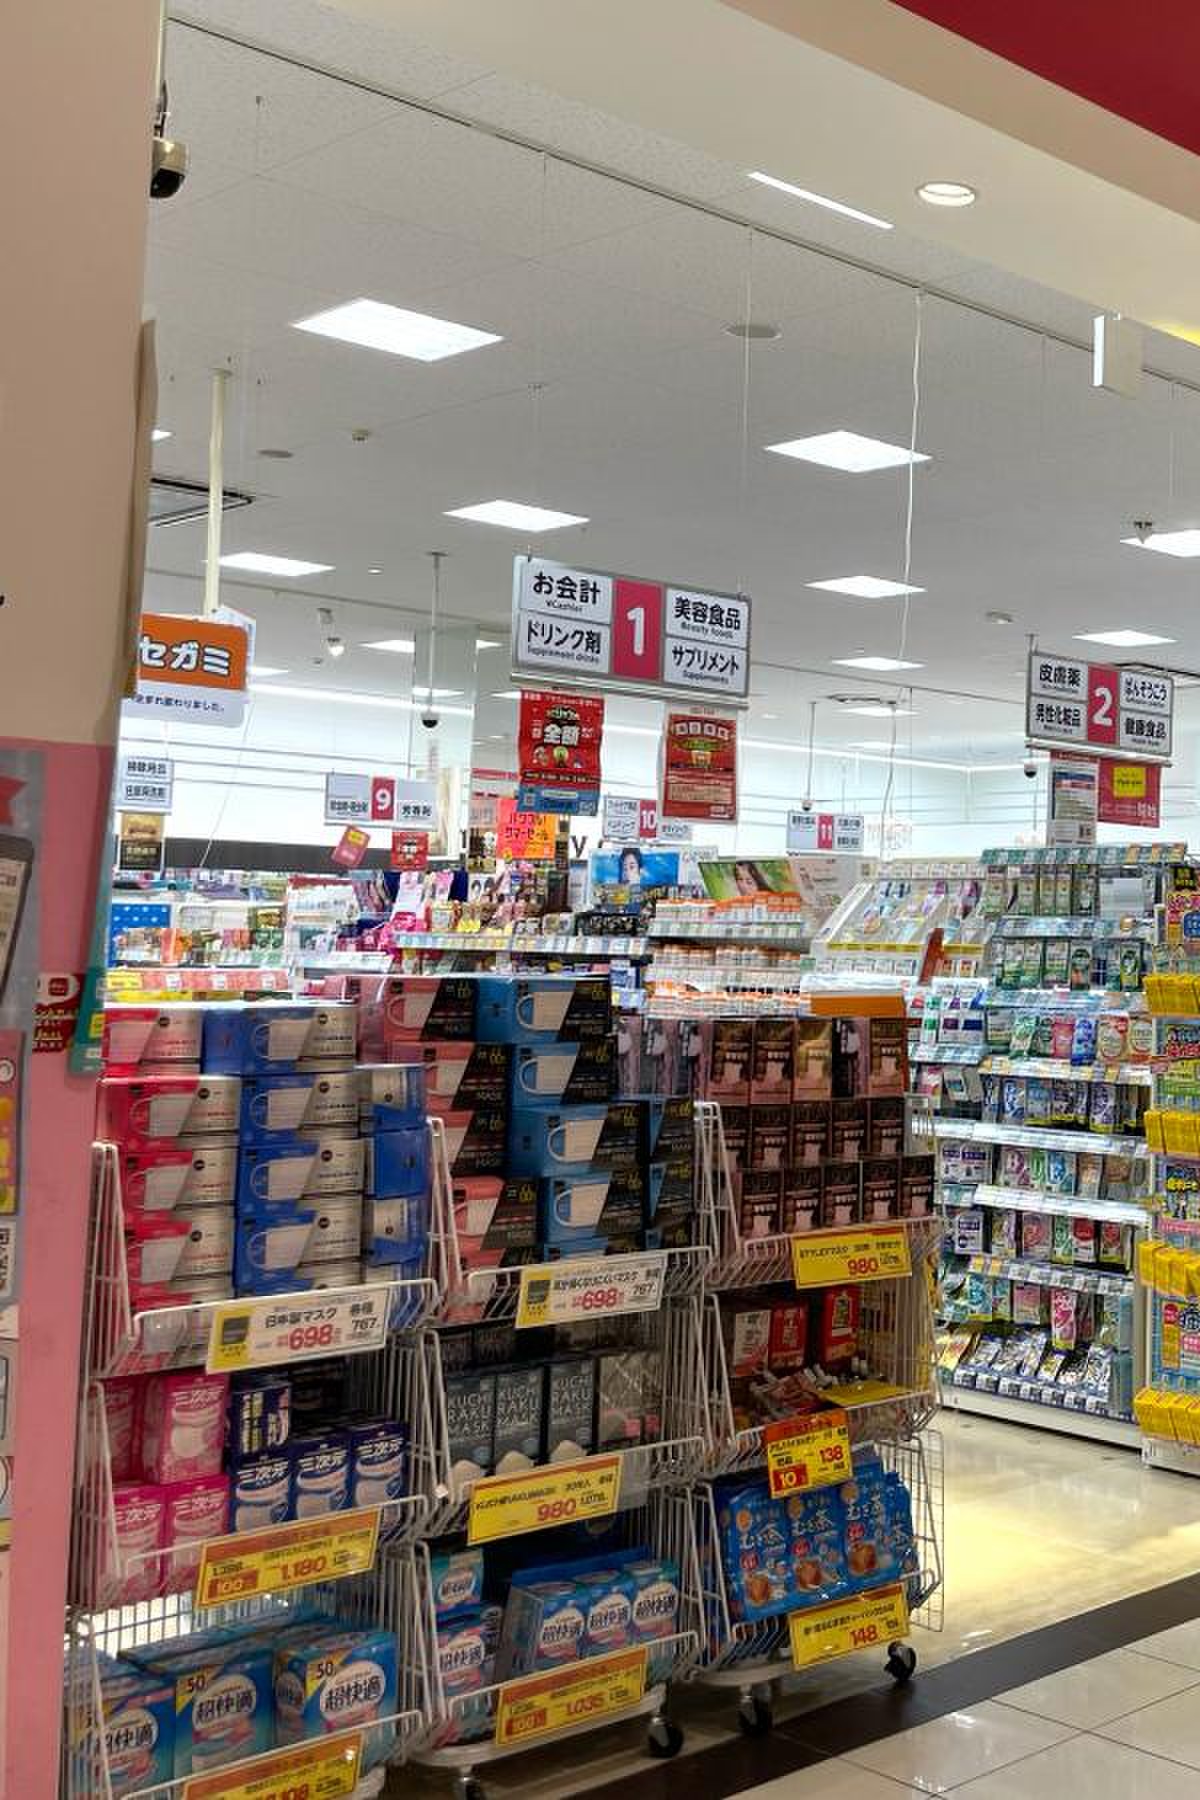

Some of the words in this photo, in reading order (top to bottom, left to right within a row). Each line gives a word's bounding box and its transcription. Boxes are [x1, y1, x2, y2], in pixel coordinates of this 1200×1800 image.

[533, 572, 600, 604] お会計
[675, 597, 740, 630] 美容食品
[527, 620, 601, 655] ドリンク剤
[627, 607, 645, 657] 1
[139, 635, 230, 677] セガミ
[672, 646, 739, 676] サプリメント
[1092, 688, 1113, 727] 2
[375, 788, 393, 811] 9
[641, 810, 656, 830] 10
[848, 1256, 879, 1276] 980
[582, 1287, 618, 1311] 698
[288, 1323, 334, 1350] 698
[819, 1445, 844, 1465] 138
[779, 1471, 797, 1487] 10
[537, 1500, 578, 1521] 980
[850, 1625, 879, 1645] 148
[195, 1689, 254, 1722] 超快適
[325, 1674, 383, 1710] 超快適
